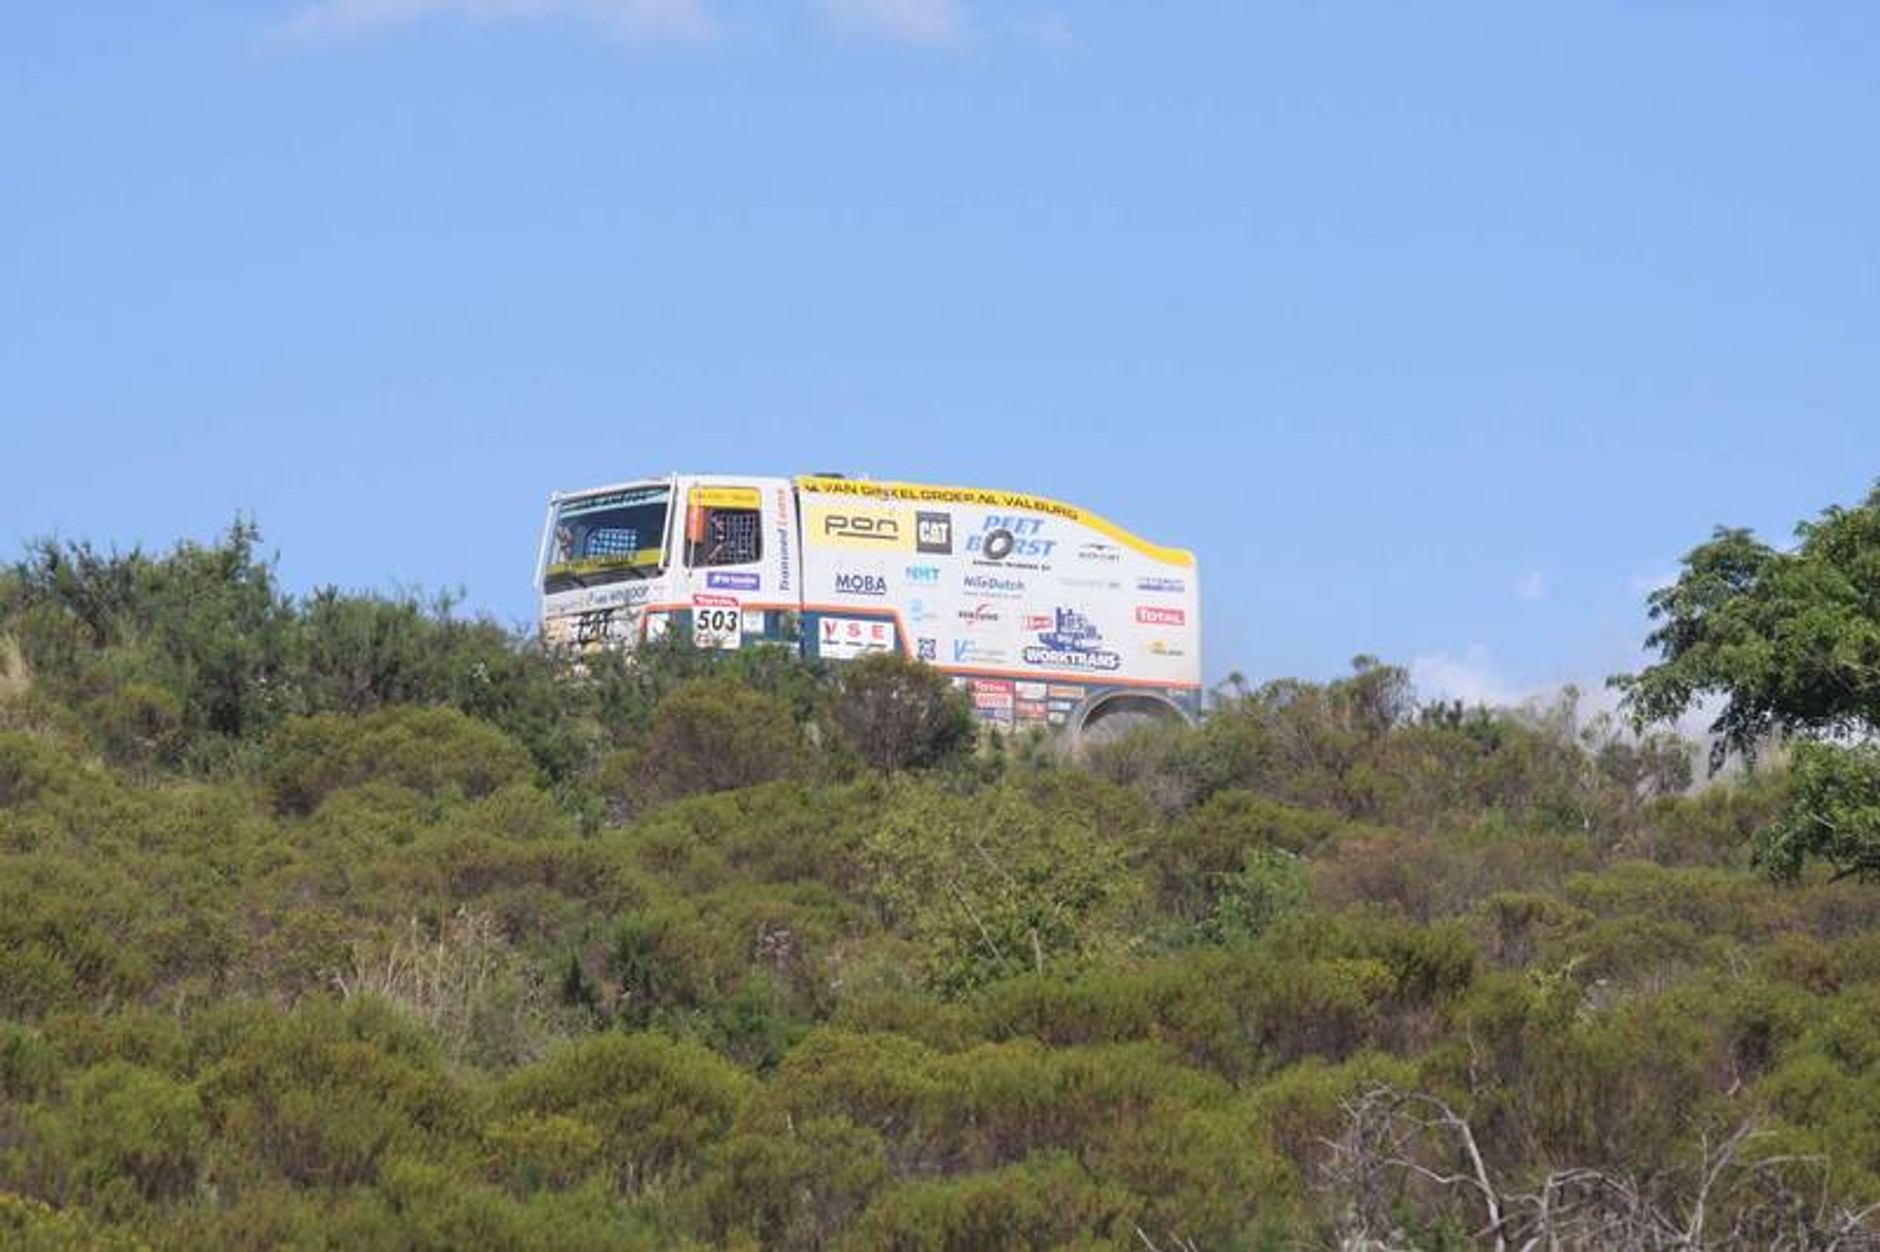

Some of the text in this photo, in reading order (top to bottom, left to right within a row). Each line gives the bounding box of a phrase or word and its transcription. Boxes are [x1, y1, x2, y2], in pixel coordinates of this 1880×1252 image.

[918, 520, 949, 545] CAT
[983, 514, 1045, 535] PEET
[965, 528, 1057, 560] BORST
[836, 574, 887, 592] MOBA
[697, 609, 738, 632] 503
